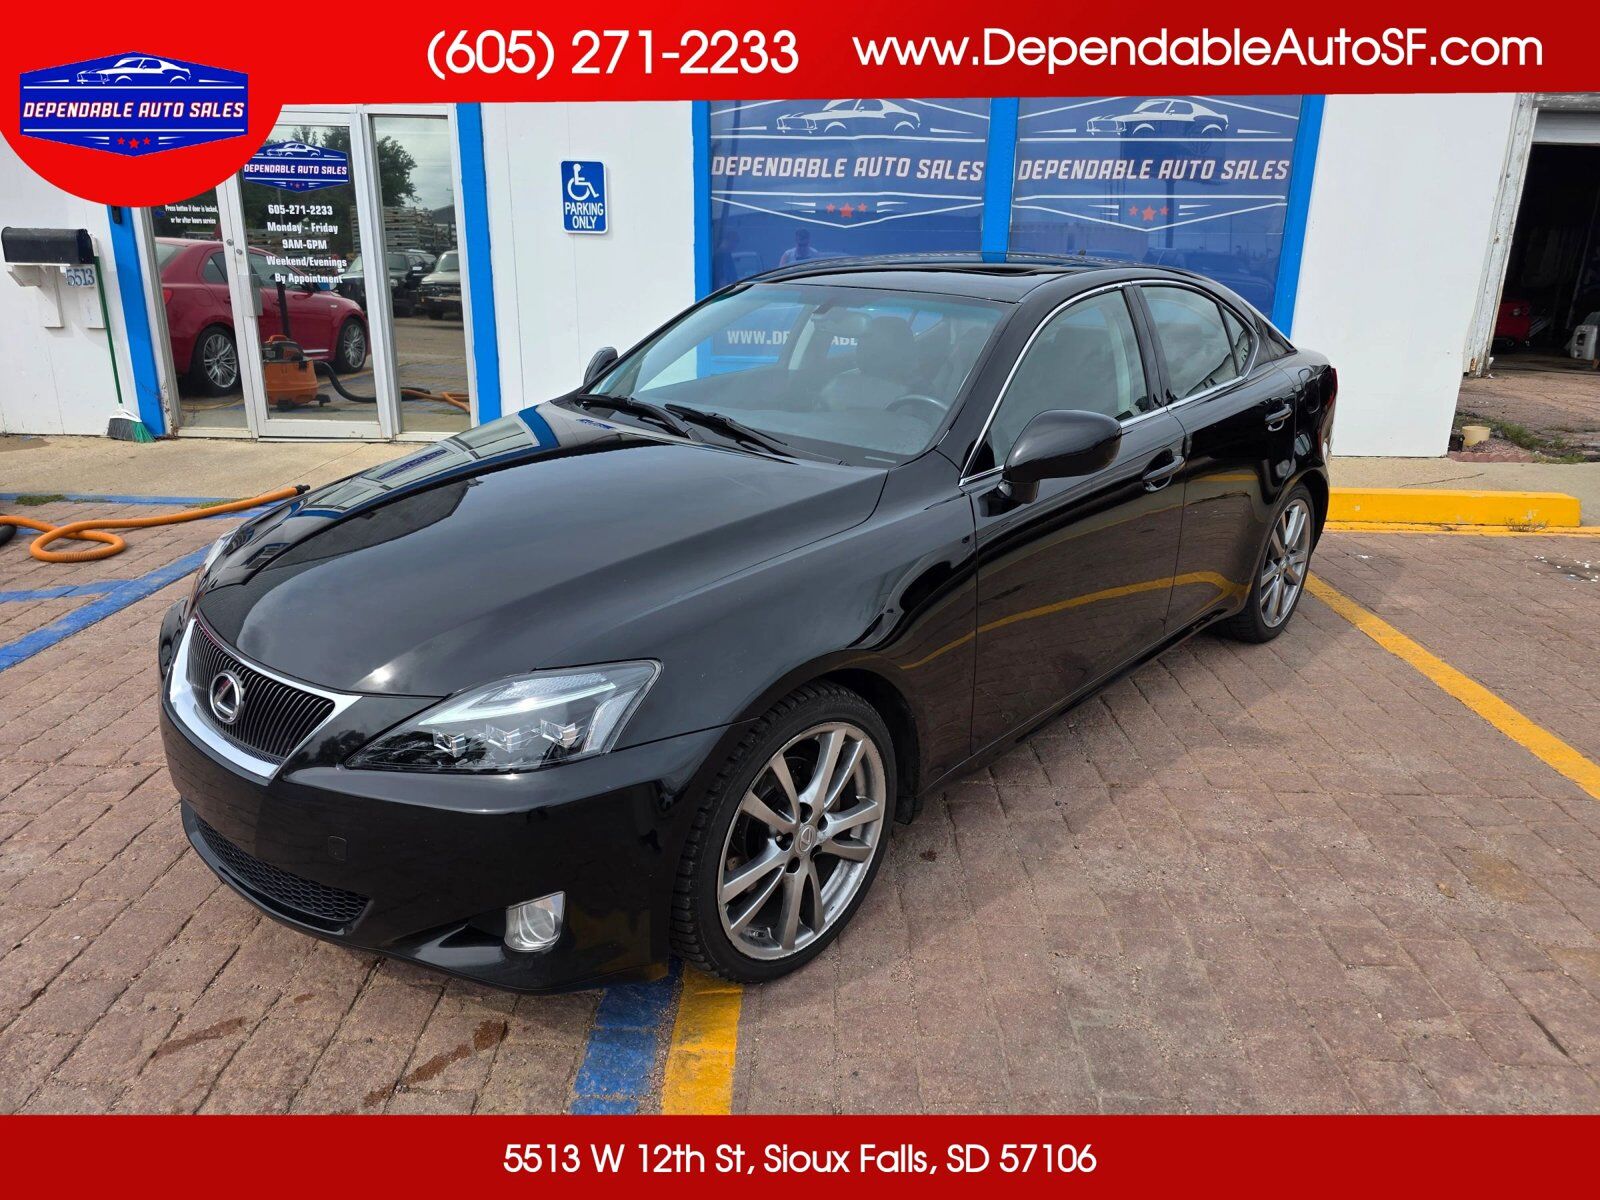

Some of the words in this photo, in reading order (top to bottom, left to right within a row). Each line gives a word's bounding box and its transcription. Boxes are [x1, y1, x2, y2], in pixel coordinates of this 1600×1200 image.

[244, 164, 296, 174] DEPENDABLE
[297, 165, 320, 174] AUTO
[321, 166, 347, 175] SALES
[711, 156, 847, 178] DEPENDABLE
[853, 156, 911, 177] AUTO
[916, 159, 985, 181] SALES
[1017, 159, 1153, 181] DEPENDABLE
[1158, 159, 1216, 180] AUTO
[1221, 159, 1290, 180] SALES
[267, 204, 333, 215] 605-271-2233
[564, 201, 604, 216] PARKING
[266, 221, 302, 234] Monday
[310, 222, 338, 235] Friday
[572, 215, 597, 229] ONLY
[282, 239, 328, 250] 9AM-6PM
[266, 255, 348, 269] Weekend/Evenings
[66, 267, 96, 287] 5513
[274, 272, 286, 284] By
[288, 272, 343, 285] Appointment
